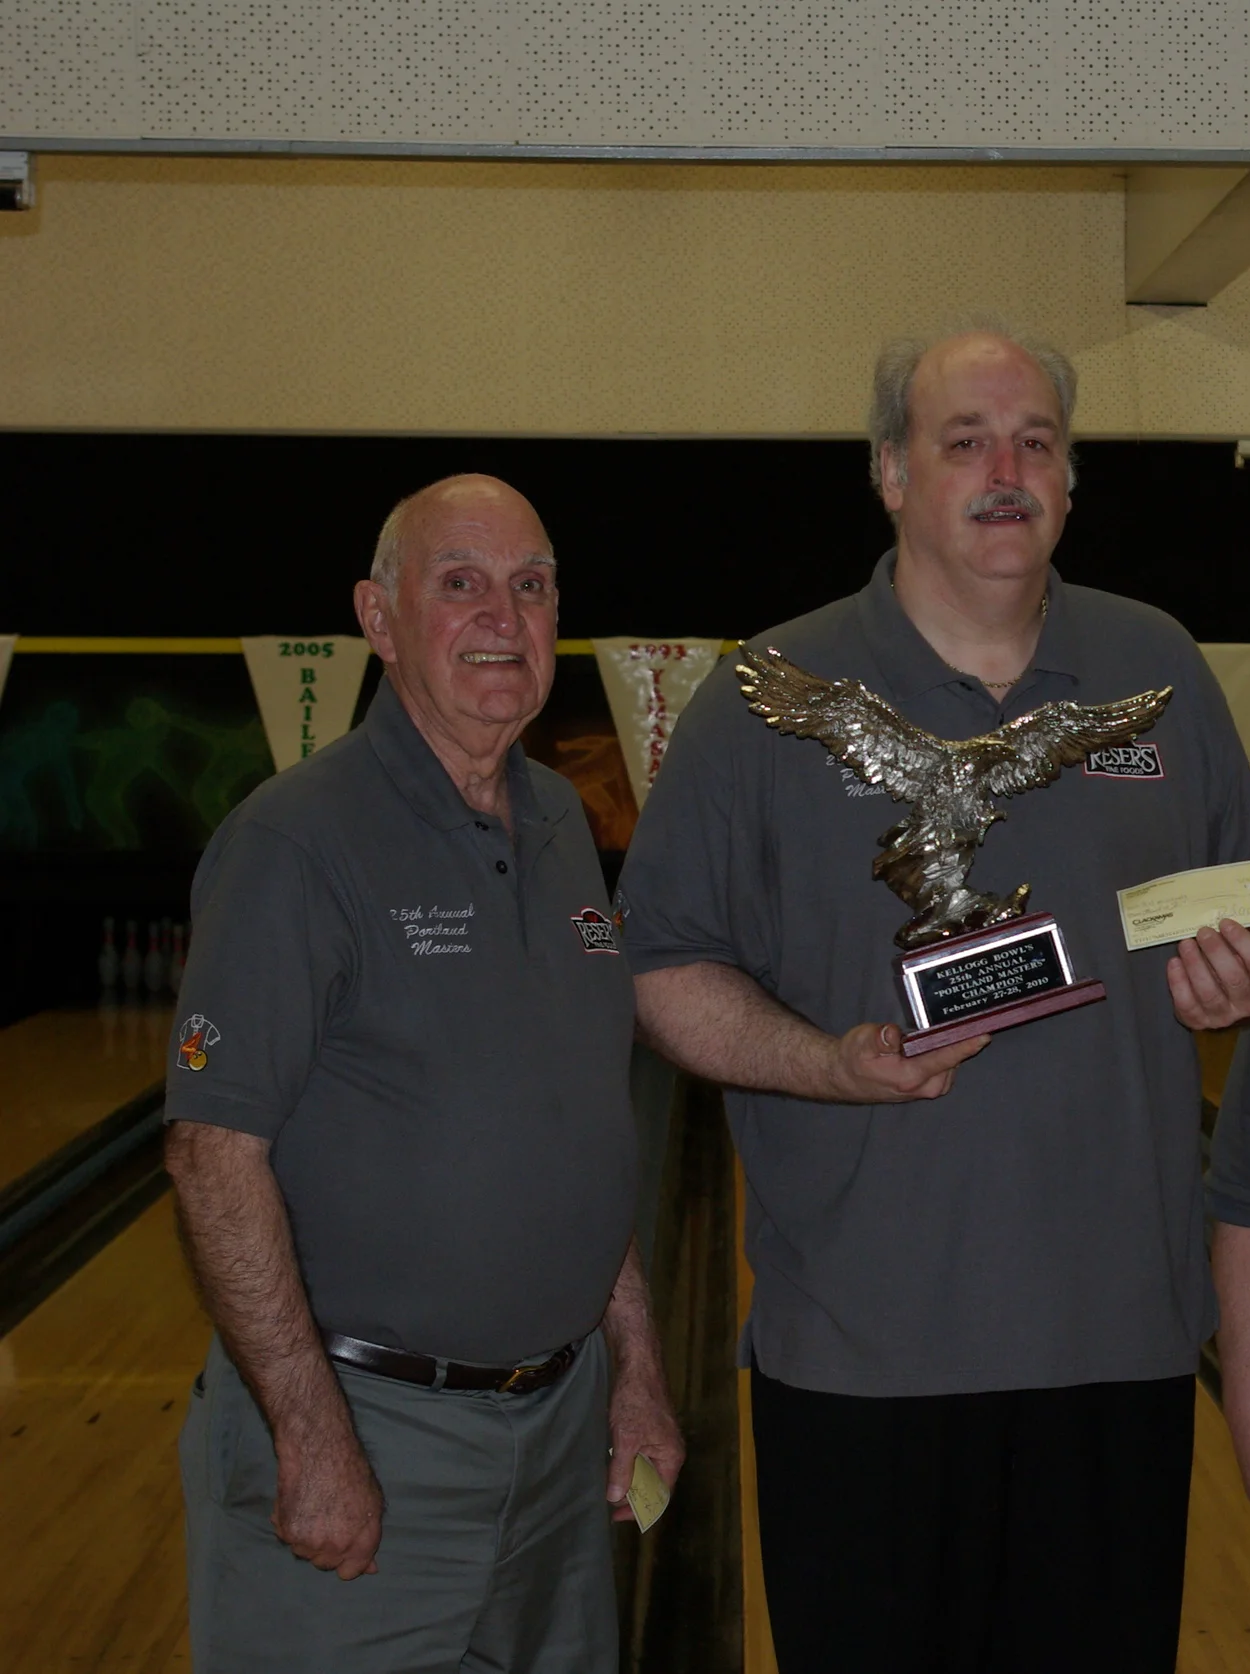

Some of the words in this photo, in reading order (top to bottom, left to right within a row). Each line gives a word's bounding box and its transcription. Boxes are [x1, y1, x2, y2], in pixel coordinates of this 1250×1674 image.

[279, 642, 334, 658] 2005
[629, 644, 686, 660] 1993
[389, 904, 424, 921] 25th
[428, 902, 475, 919] Annual
[404, 923, 468, 939] Portland
[411, 940, 472, 955] Masters
[936, 957, 989, 980] KELLOGG
[993, 943, 1035, 960] BOWL'S
[949, 972, 973, 984] 25th
[978, 956, 1027, 976] ANNUAL
[933, 975, 994, 998] "PORTLAND
[997, 958, 1046, 979] MASTERS"
[961, 975, 1024, 1000] CHAMPION
[942, 997, 988, 1015] February
[993, 985, 1022, 1000] 27-28,
[1026, 976, 1049, 990] 2010
